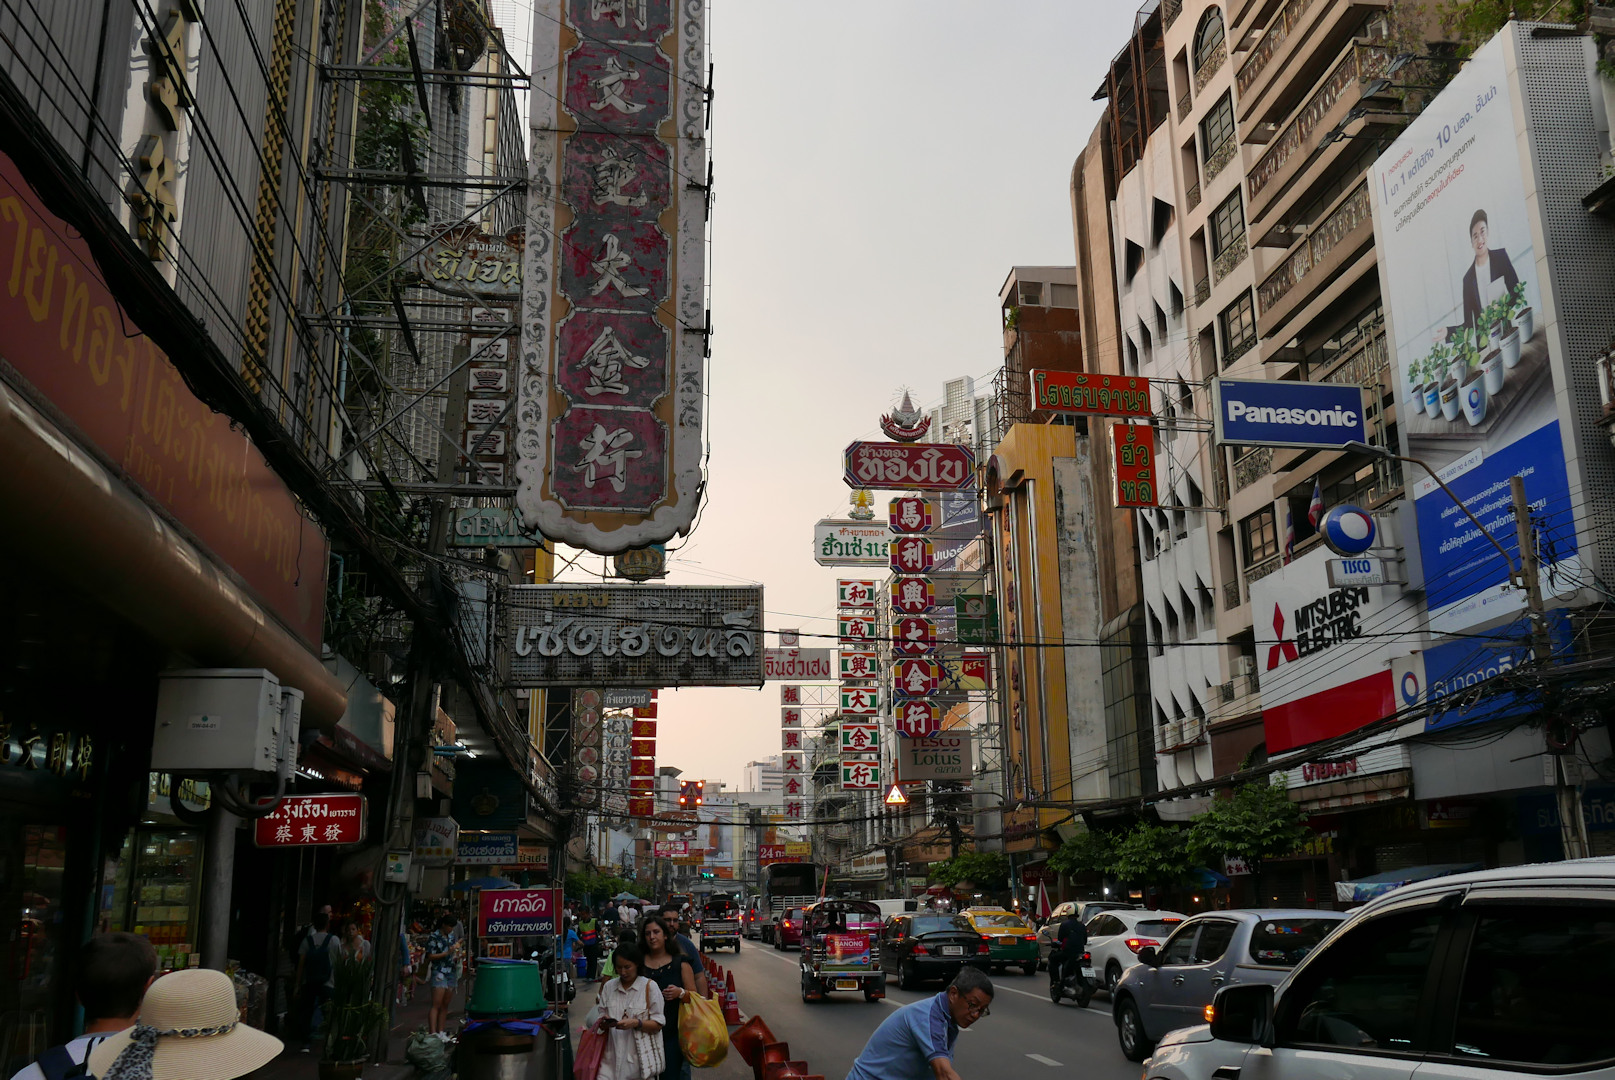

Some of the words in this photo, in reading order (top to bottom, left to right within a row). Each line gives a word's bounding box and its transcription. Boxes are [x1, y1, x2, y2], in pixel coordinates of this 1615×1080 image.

[1436, 124, 1451, 149] 10
[1036, 374, 1149, 412] โรงรับจำนำ
[1228, 400, 1358, 427] Panasonic
[859, 445, 909, 459] ห้างทอง
[1120, 470, 1152, 502] หลี
[1342, 559, 1371, 574] TISCO
[552, 592, 609, 608] ทอง
[1295, 586, 1370, 633] MITSUBISHI
[901, 501, 930, 734] 馬利興大金行
[1297, 612, 1362, 659] ELECTRIC
[965, 660, 985, 672] KFC
[848, 585, 870, 785] 和成興大金行
[783, 688, 801, 818] 振和興大金行
[912, 738, 960, 747] TESCO
[913, 752, 961, 766] Lotus
[274, 823, 343, 844] 蔡東發
[760, 847, 773, 859] 24
